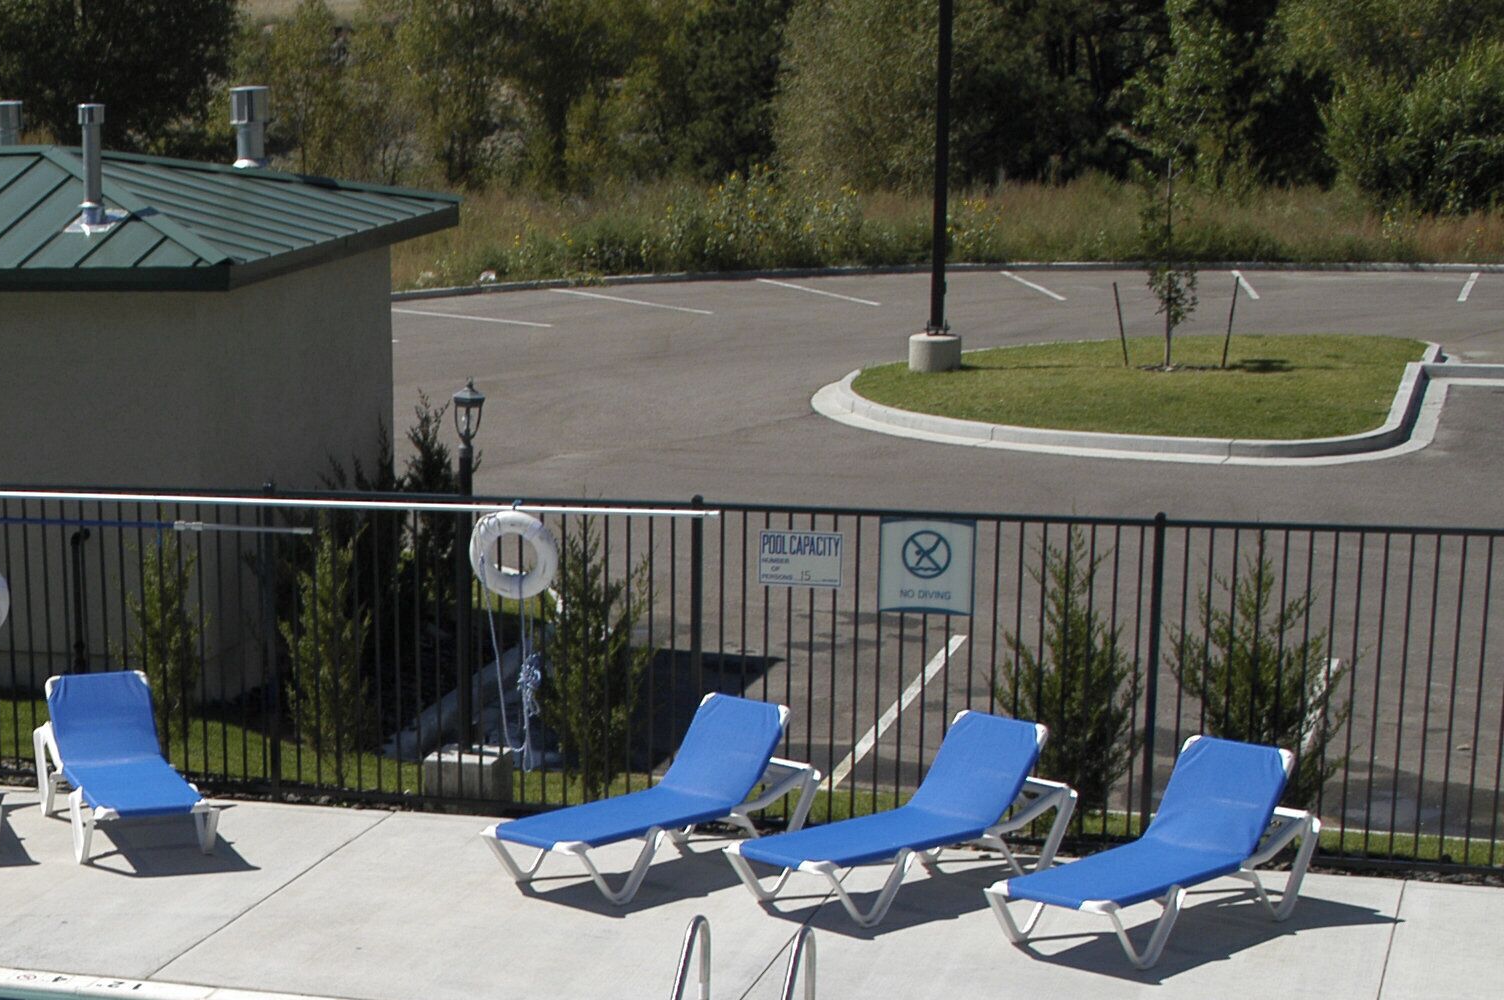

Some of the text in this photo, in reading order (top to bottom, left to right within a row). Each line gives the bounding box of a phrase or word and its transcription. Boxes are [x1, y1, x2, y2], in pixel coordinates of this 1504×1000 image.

[762, 534, 840, 557] POOL CAPACITY
[899, 589, 952, 601] NO DIVING
